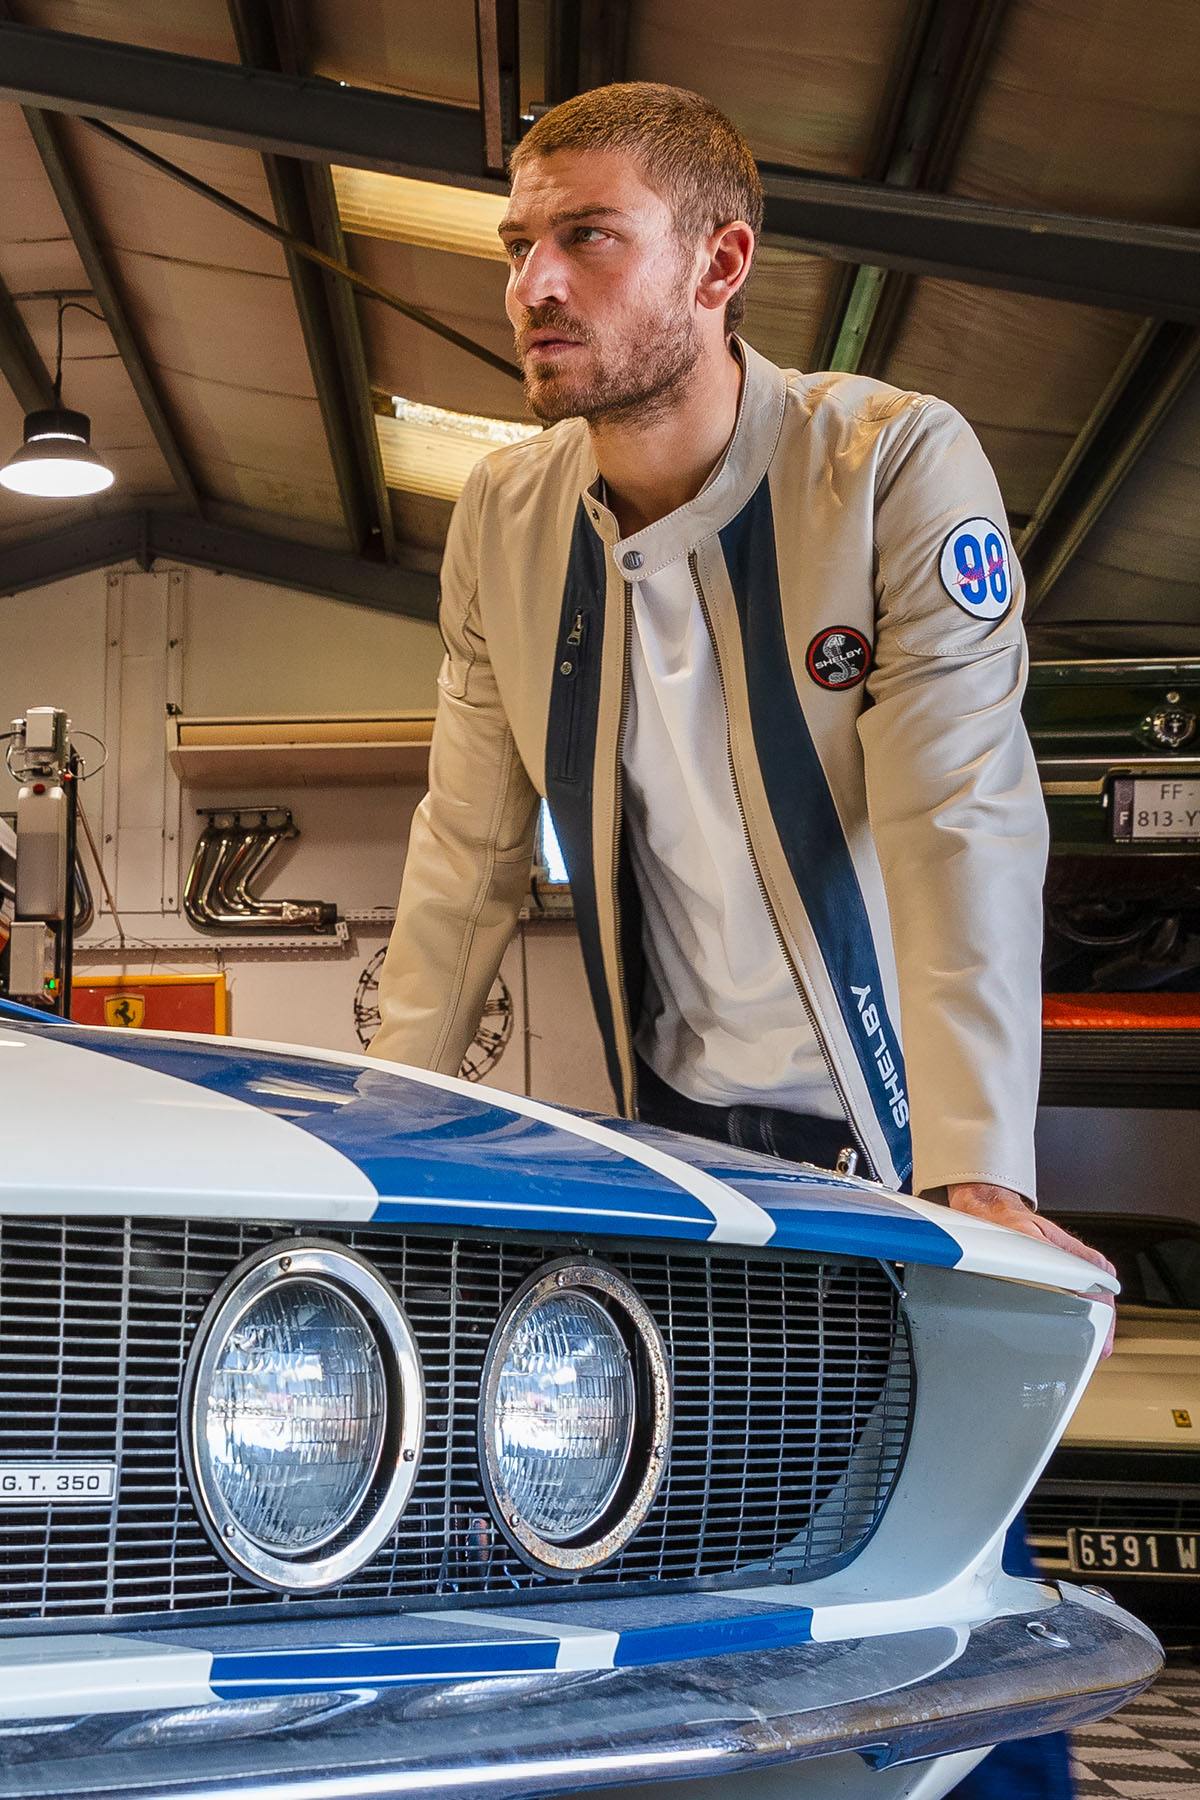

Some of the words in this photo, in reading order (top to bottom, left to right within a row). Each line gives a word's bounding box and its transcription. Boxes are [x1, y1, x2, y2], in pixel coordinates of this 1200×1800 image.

[954, 533, 1007, 605] 98
[815, 648, 862, 669] SHELBY
[1119, 811, 1129, 825] F
[850, 985, 909, 1129] SHELBY
[2, 1475, 46, 1491] G.T.
[56, 1475, 100, 1491] 350
[1176, 1536, 1197, 1569] W
